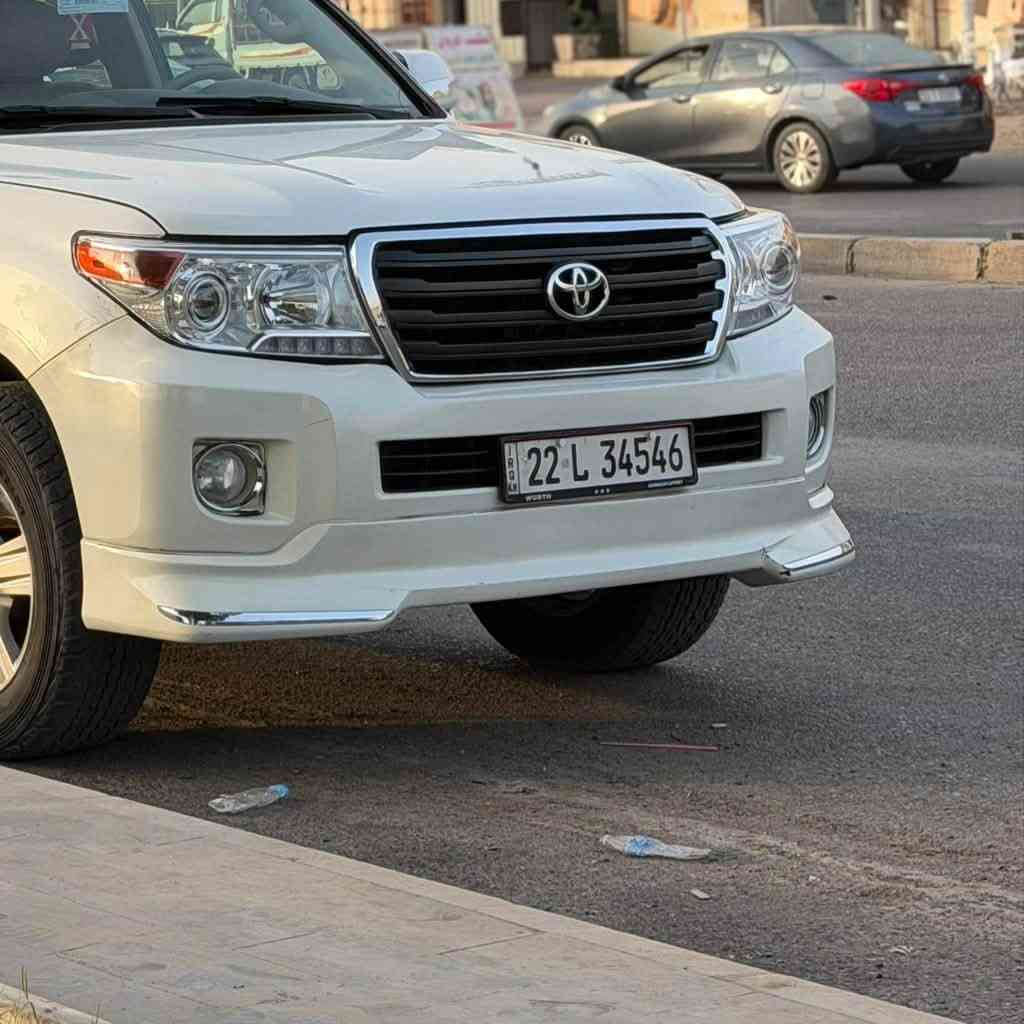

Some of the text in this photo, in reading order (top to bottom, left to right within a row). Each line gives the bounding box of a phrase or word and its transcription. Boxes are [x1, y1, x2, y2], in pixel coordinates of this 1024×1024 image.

[527, 432, 684, 487] 22 L 34546
